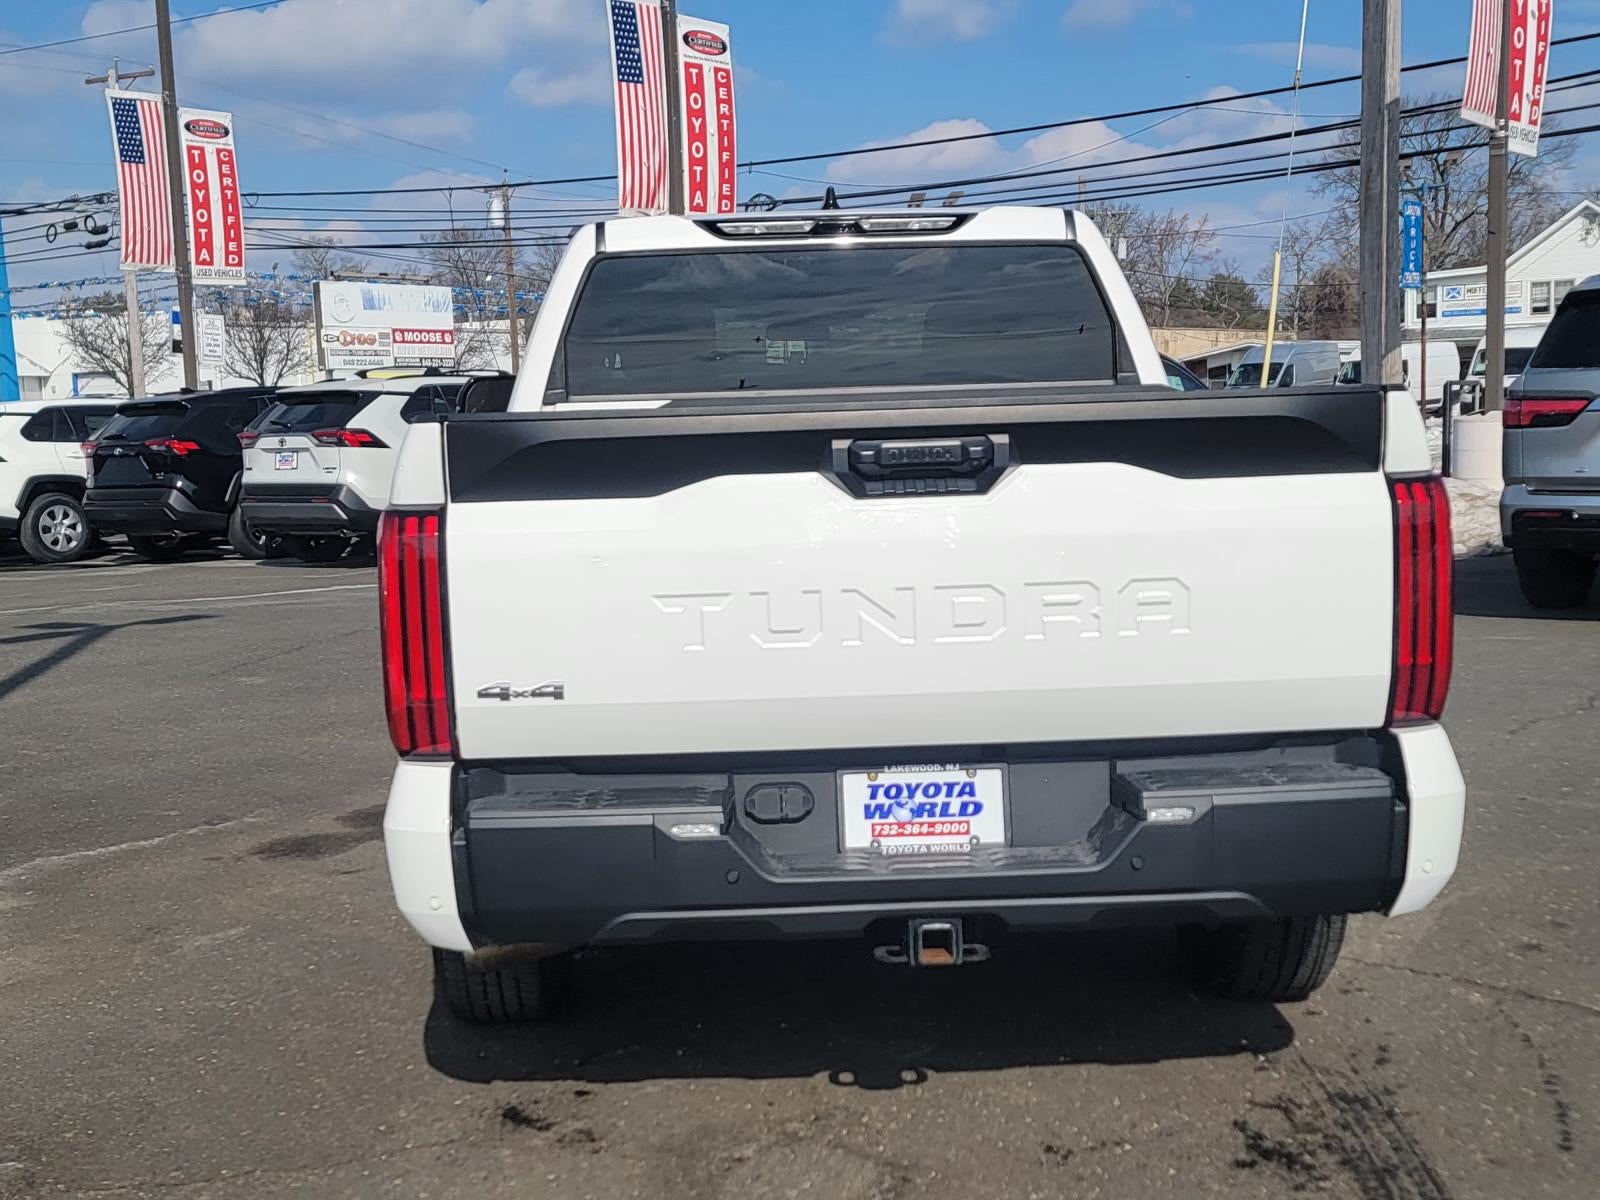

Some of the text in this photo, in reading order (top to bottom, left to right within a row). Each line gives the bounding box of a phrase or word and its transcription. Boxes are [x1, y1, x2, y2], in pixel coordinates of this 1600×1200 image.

[689, 68, 704, 207] TOYOTA
[717, 71, 732, 211] CERTIFIED
[191, 149, 211, 262] TOYOTA
[220, 151, 239, 264] CERTIFIED
[196, 268, 242, 278] USED VEHICLES
[404, 331, 443, 342] MOOSE
[652, 577, 1191, 652] TUNDRA
[477, 680, 565, 701] 4x4
[945, 763, 960, 771] NJ
[867, 781, 977, 800] TOYOTA
[873, 822, 968, 836] 732-364-9000
[881, 843, 971, 855] TOYOTA WORLD
